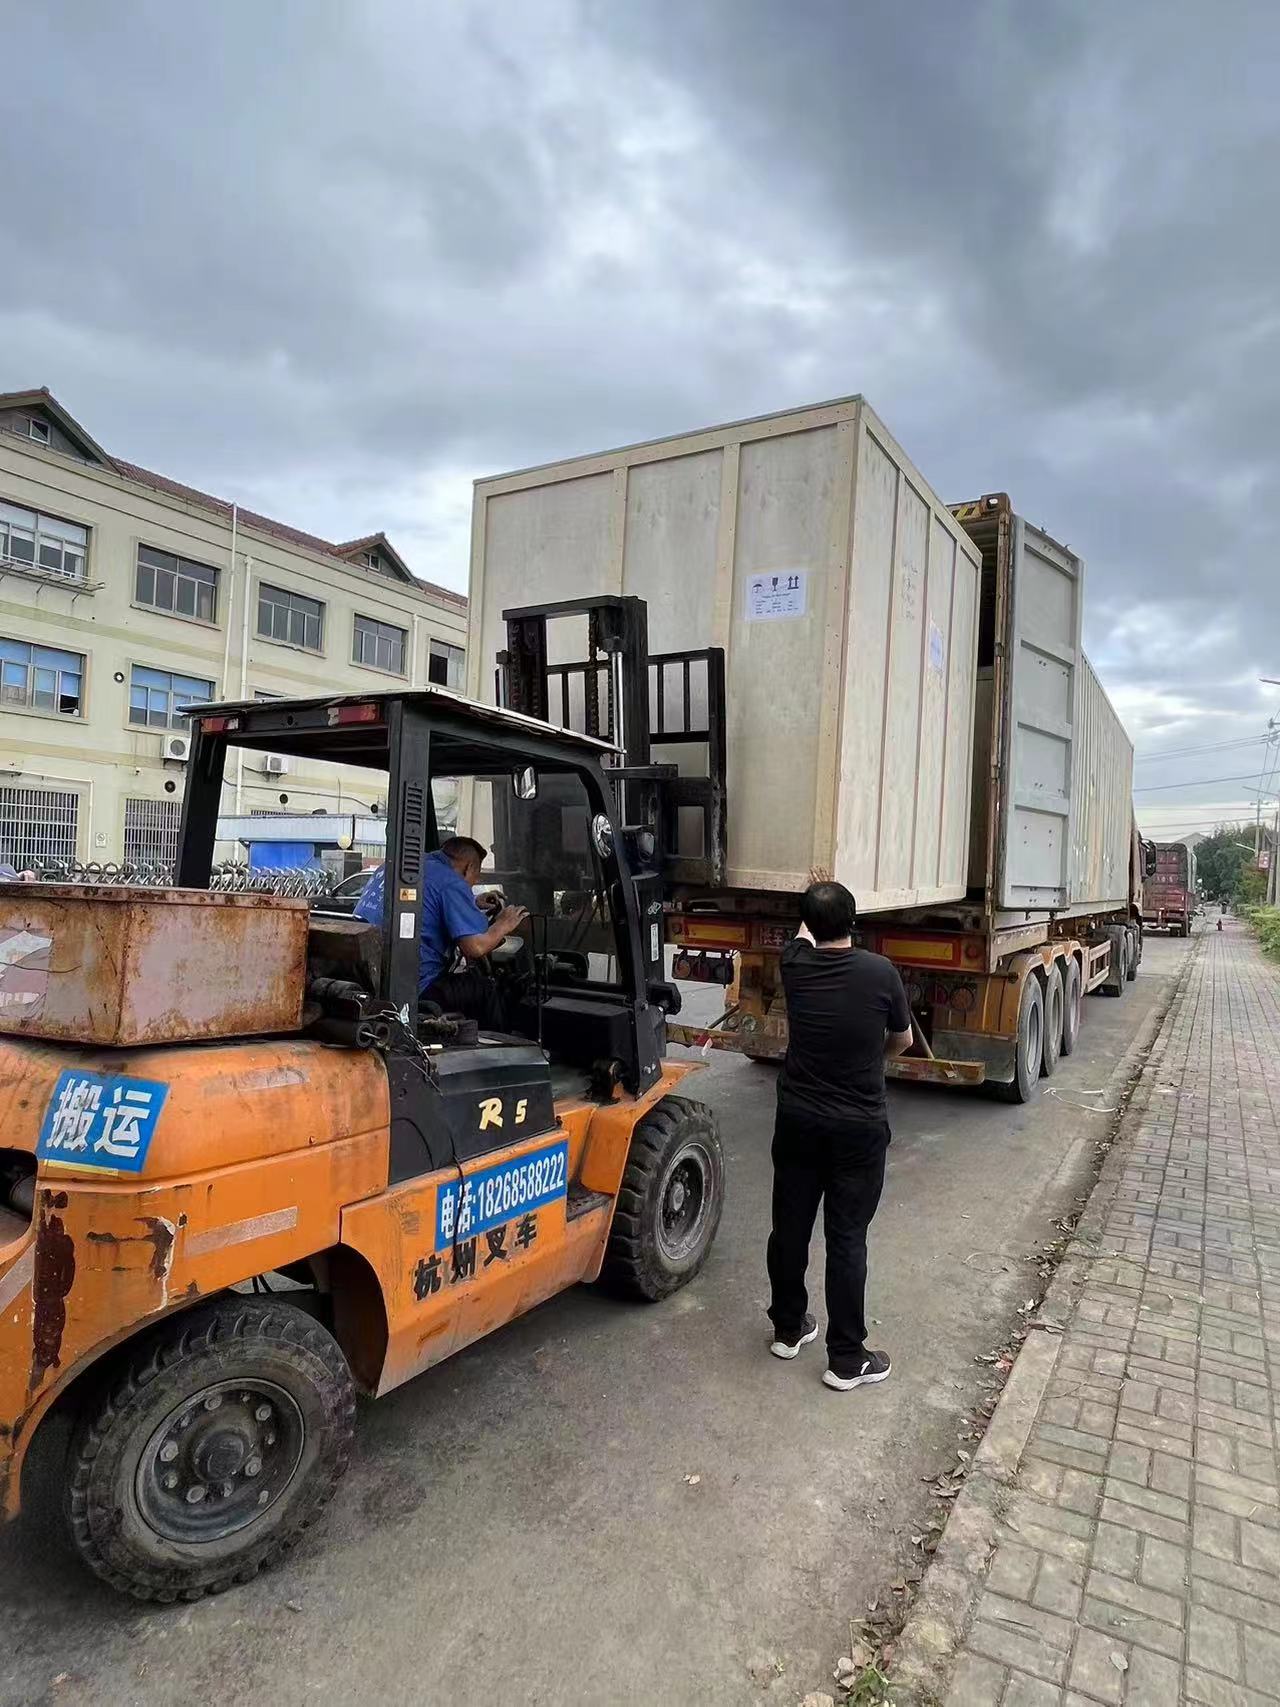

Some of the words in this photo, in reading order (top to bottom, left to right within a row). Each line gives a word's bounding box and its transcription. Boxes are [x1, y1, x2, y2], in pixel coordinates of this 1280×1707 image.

[46, 1078, 152, 1158] 搬运
[479, 1097, 504, 1130] R
[441, 1151, 565, 1240] 电话:18268588222
[413, 1212, 538, 1301] 杭州叉车
